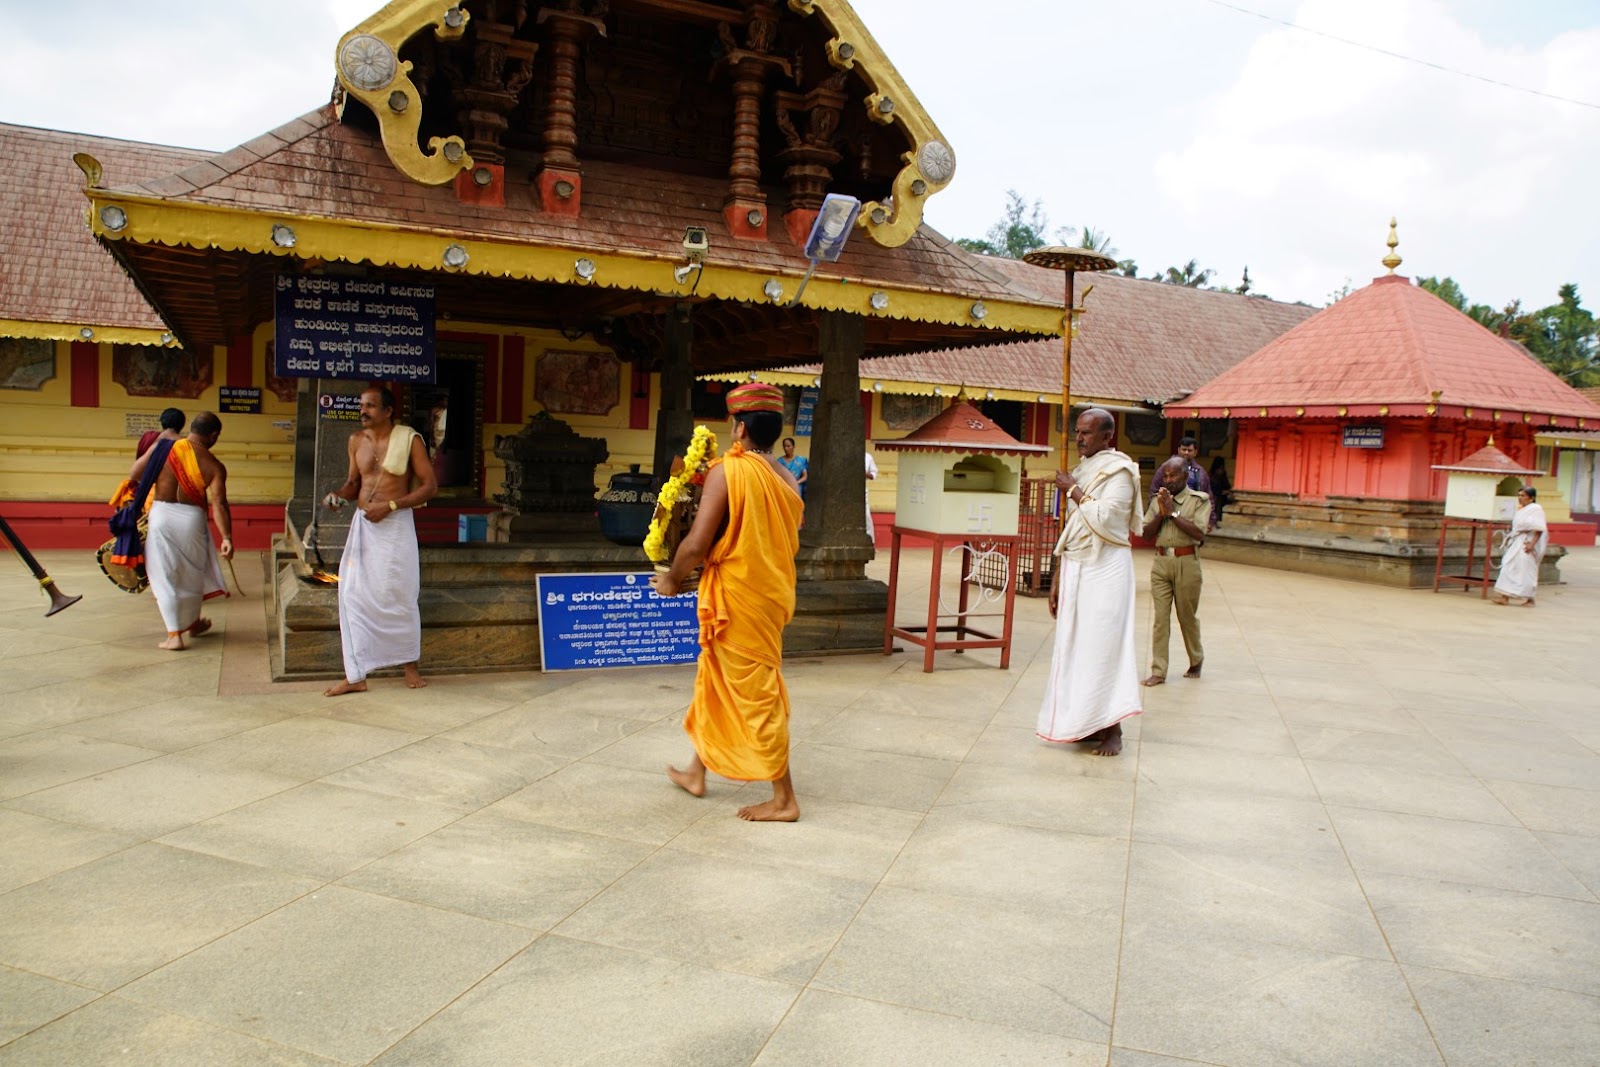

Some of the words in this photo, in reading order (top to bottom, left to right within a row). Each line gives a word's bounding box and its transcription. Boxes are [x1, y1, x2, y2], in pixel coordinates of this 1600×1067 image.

[277, 275, 292, 291] ಶ್ರೀ
[298, 276, 340, 295] ಕ್ಷೇತ್ರದಲ್ಲಿ
[345, 280, 385, 295] ದೇವರಿಗೆ
[390, 285, 434, 299] ಅರ್ಪಿಸುವ
[295, 298, 322, 310] ಹರಕೆ
[327, 300, 360, 312] ಕಾಣಿಕೆ
[365, 303, 419, 322] ವಸ್ತುಗಳನ್ನು
[294, 318, 350, 336] ಹುಂಡಿಯಲ್ಲಿ
[354, 322, 424, 337] ಹಾಕುವುದರಿಂದ
[289, 337, 315, 356] ನಿಮ್ಮ
[286, 357, 320, 371] ದೇವರ
[325, 359, 355, 378] ಕೃಪೆಗೆ
[359, 362, 431, 379] ಪಾತ್ರರಾಗುತ್ತೀರಿ
[546, 591, 565, 605] ಶ್ರೀ
